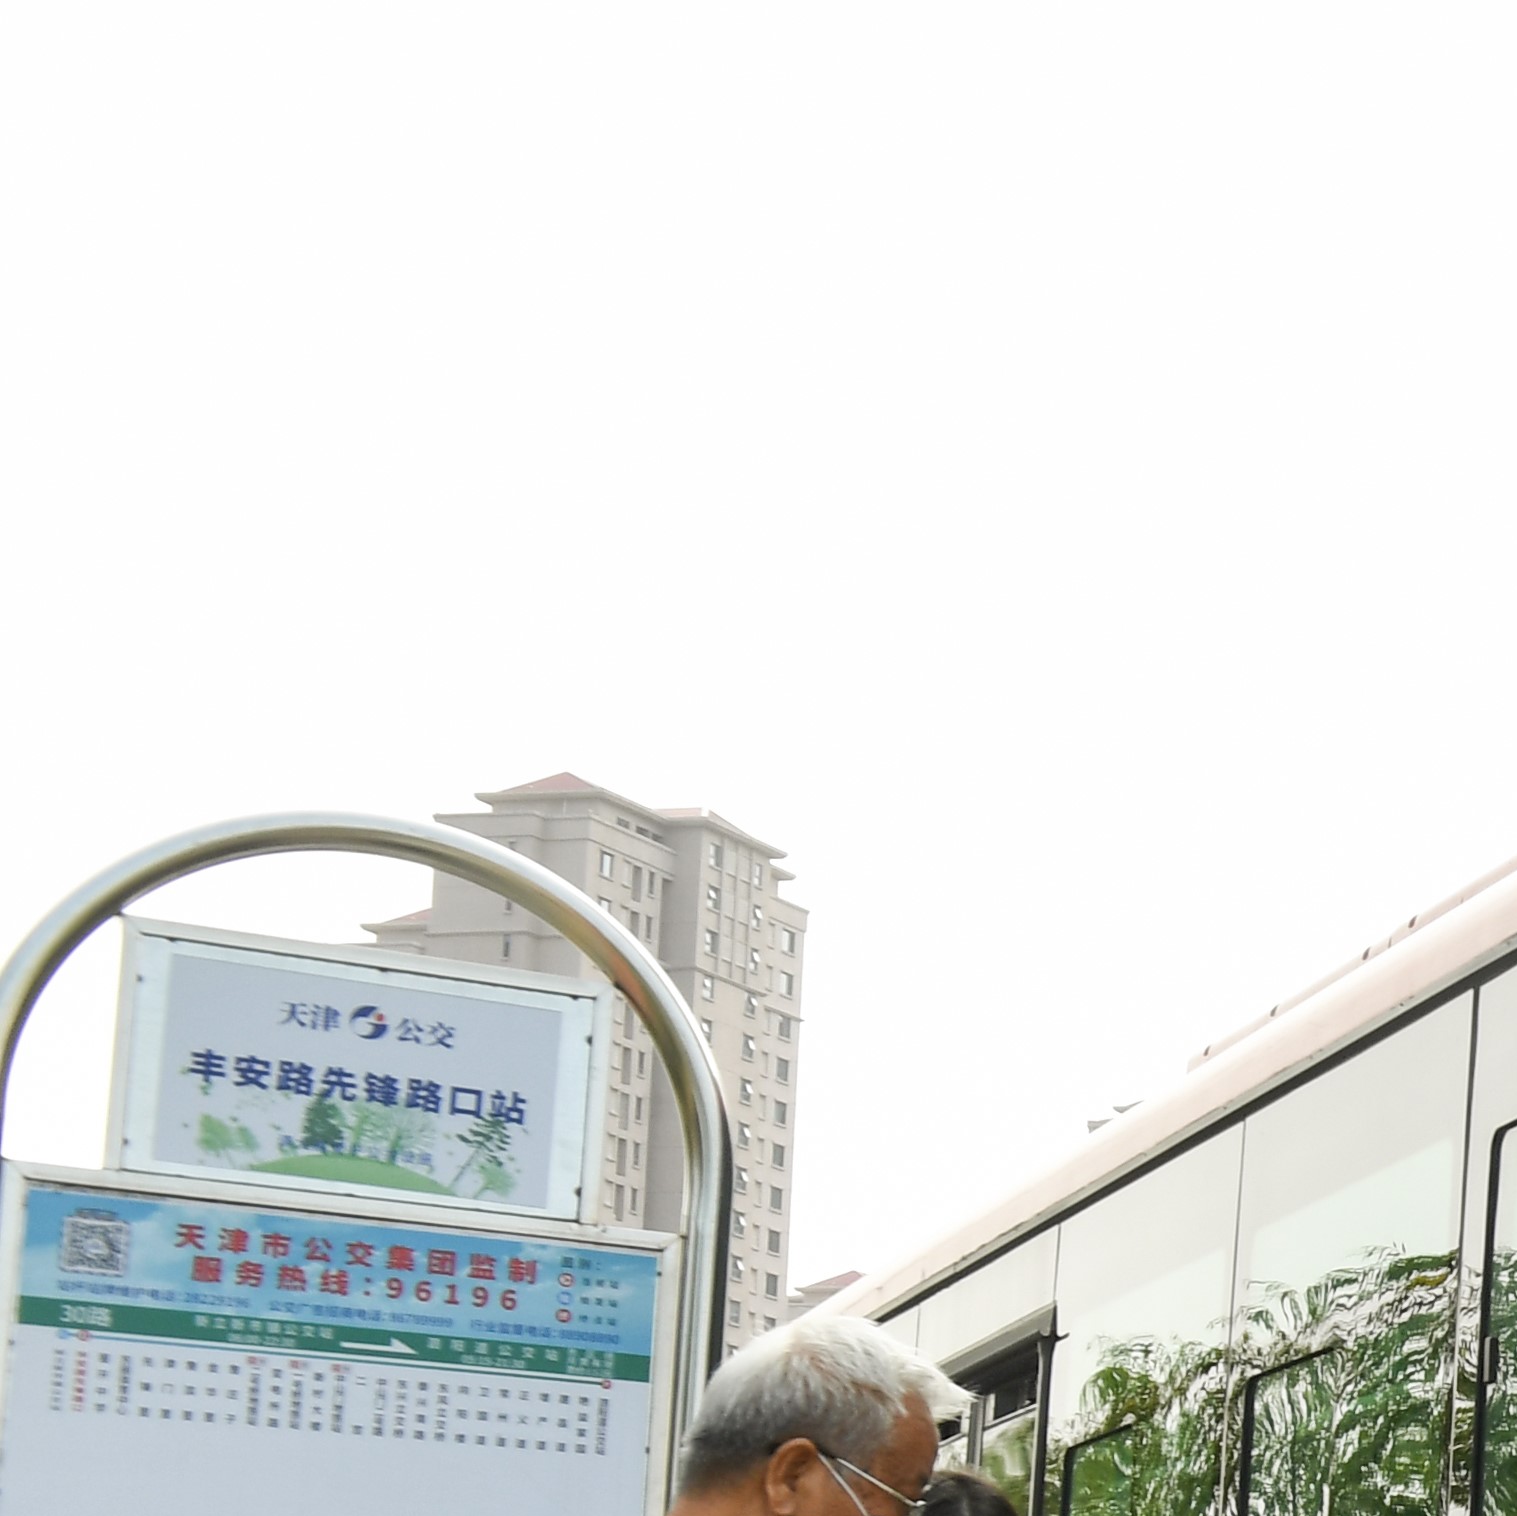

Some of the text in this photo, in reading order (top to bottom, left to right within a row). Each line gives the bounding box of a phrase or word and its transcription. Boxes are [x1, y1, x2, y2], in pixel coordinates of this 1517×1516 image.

[280, 1001, 456, 1049] 天津 公交
[188, 1048, 528, 1126] 丰安路先锋路口站
[174, 1222, 539, 1286] 天津市公交集团监制
